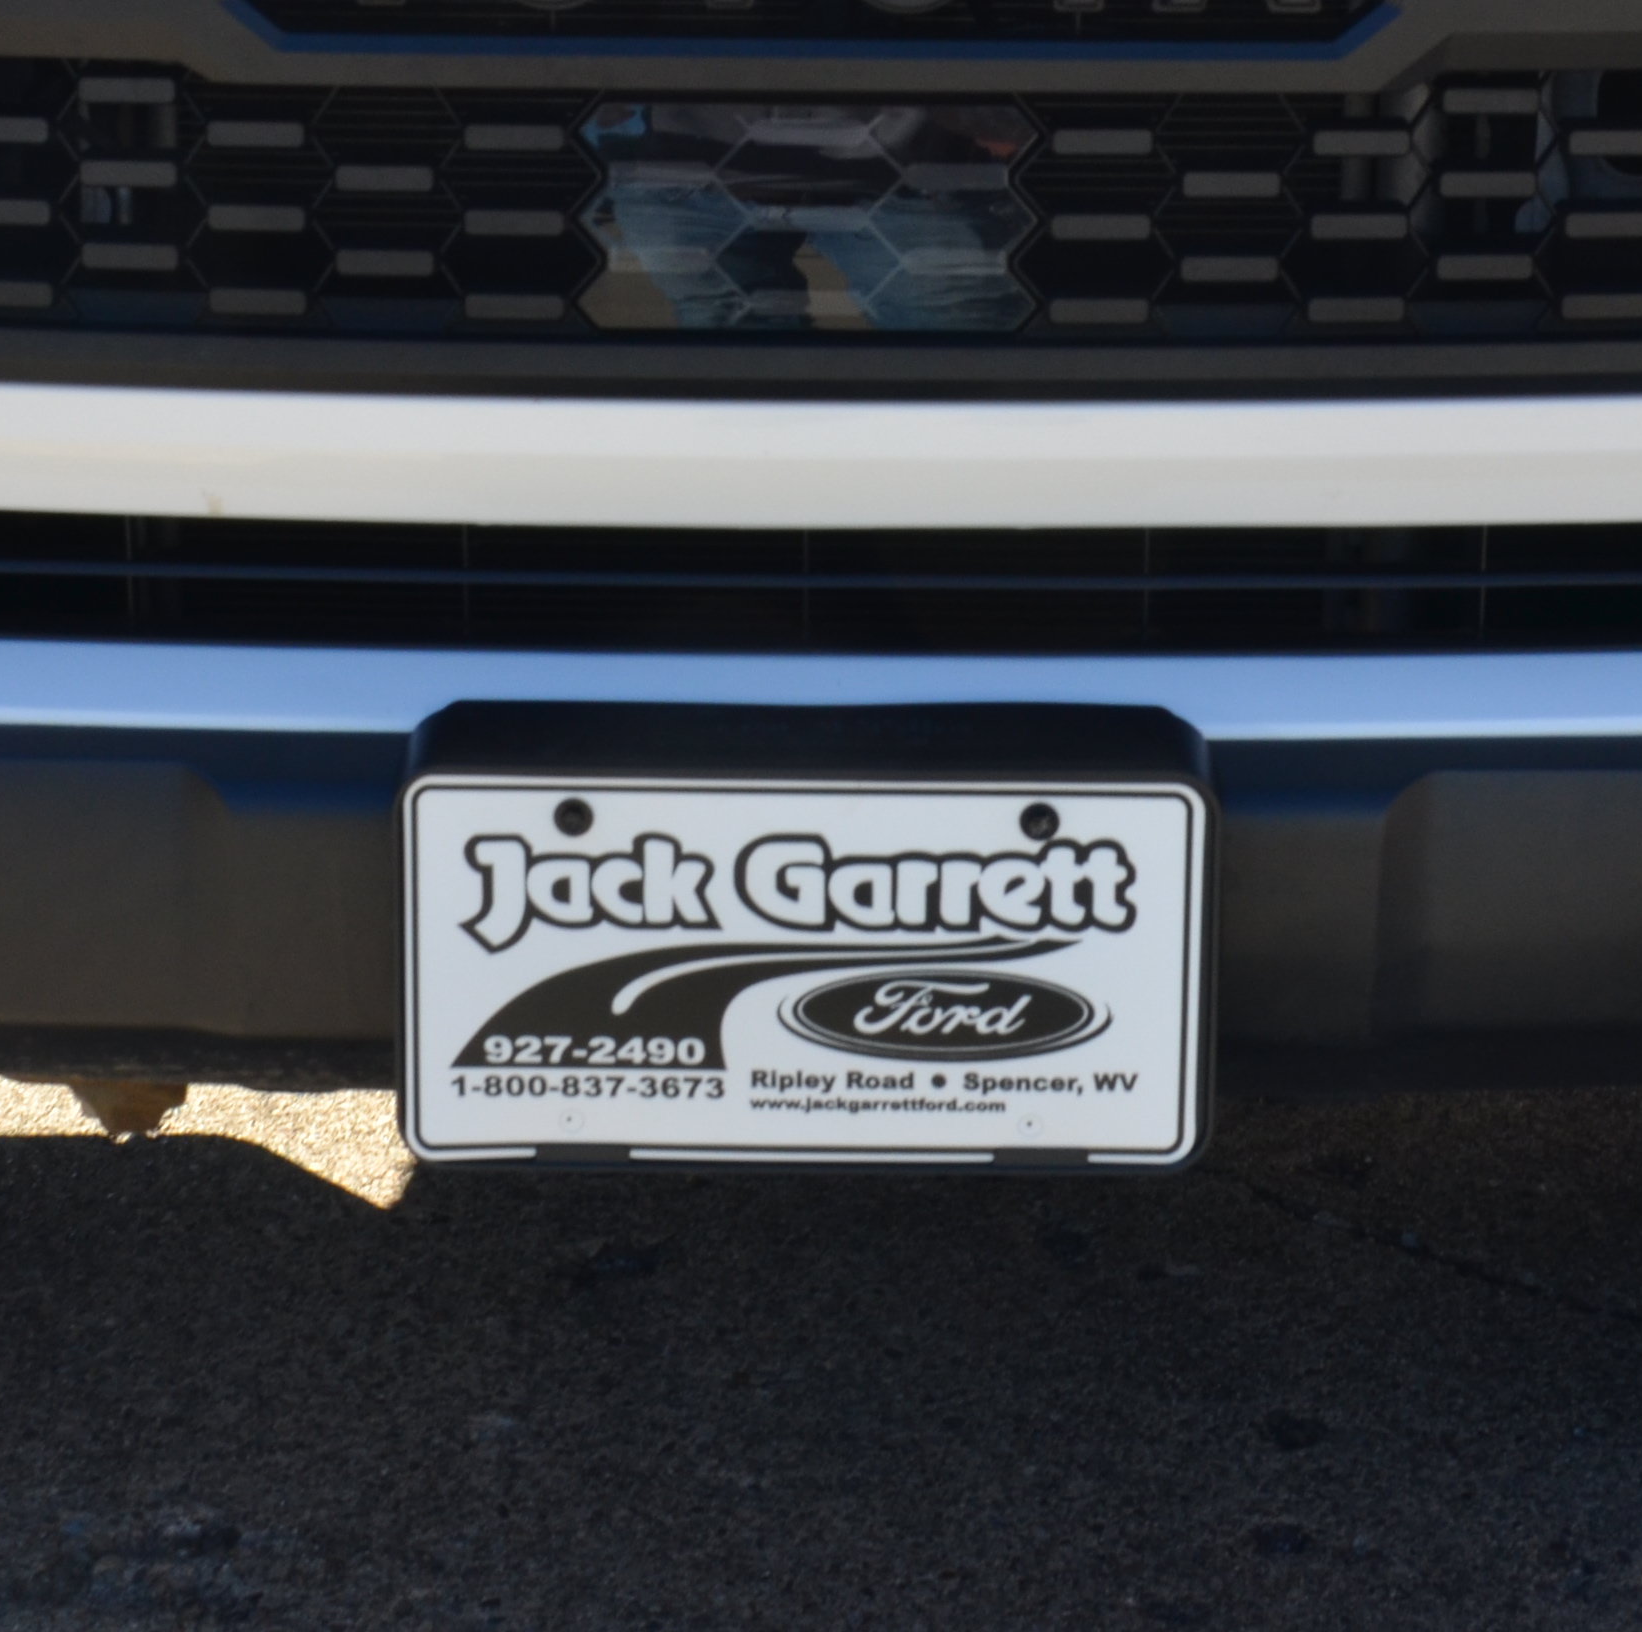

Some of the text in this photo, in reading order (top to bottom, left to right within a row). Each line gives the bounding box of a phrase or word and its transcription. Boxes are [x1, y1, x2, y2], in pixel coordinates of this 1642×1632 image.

[459, 832, 1139, 954] Jack Garrett
[851, 978, 1035, 1038] Ford
[483, 1035, 706, 1066] 927-2490
[450, 1074, 726, 1100] 1-800-837-3673
[750, 1070, 1139, 1097] Ripley Road Spencer, WV
[749, 1096, 1007, 1114] www.jackgarrettford.com
